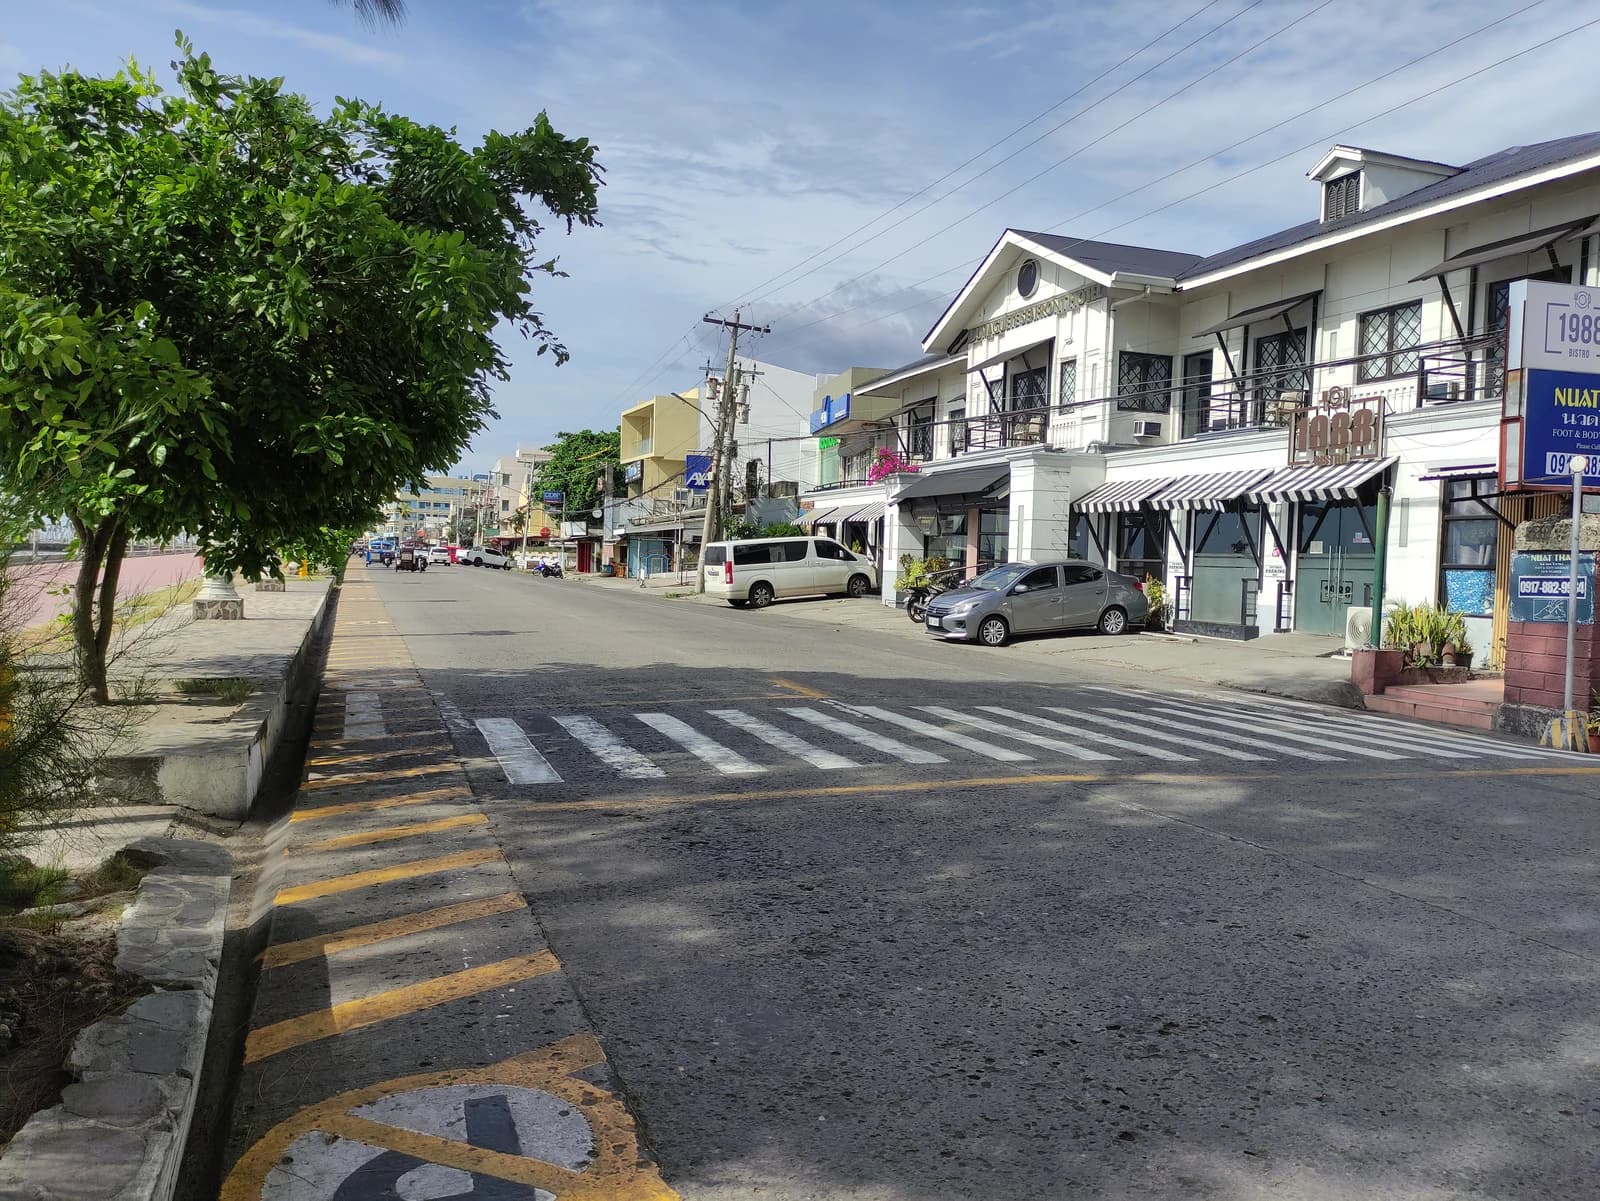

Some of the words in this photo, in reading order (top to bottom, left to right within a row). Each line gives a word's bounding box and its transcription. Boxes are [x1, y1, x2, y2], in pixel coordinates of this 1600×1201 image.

[1559, 313, 1600, 345] 1988
[1568, 348, 1590, 359] BISTRO
[1554, 387, 1600, 408] NUAT
[1297, 409, 1374, 452] 1988
[1552, 428, 1573, 438] FOOT
[1574, 430, 1581, 439] &
[1582, 430, 1600, 440] BOD
[1555, 554, 1572, 562] THA
